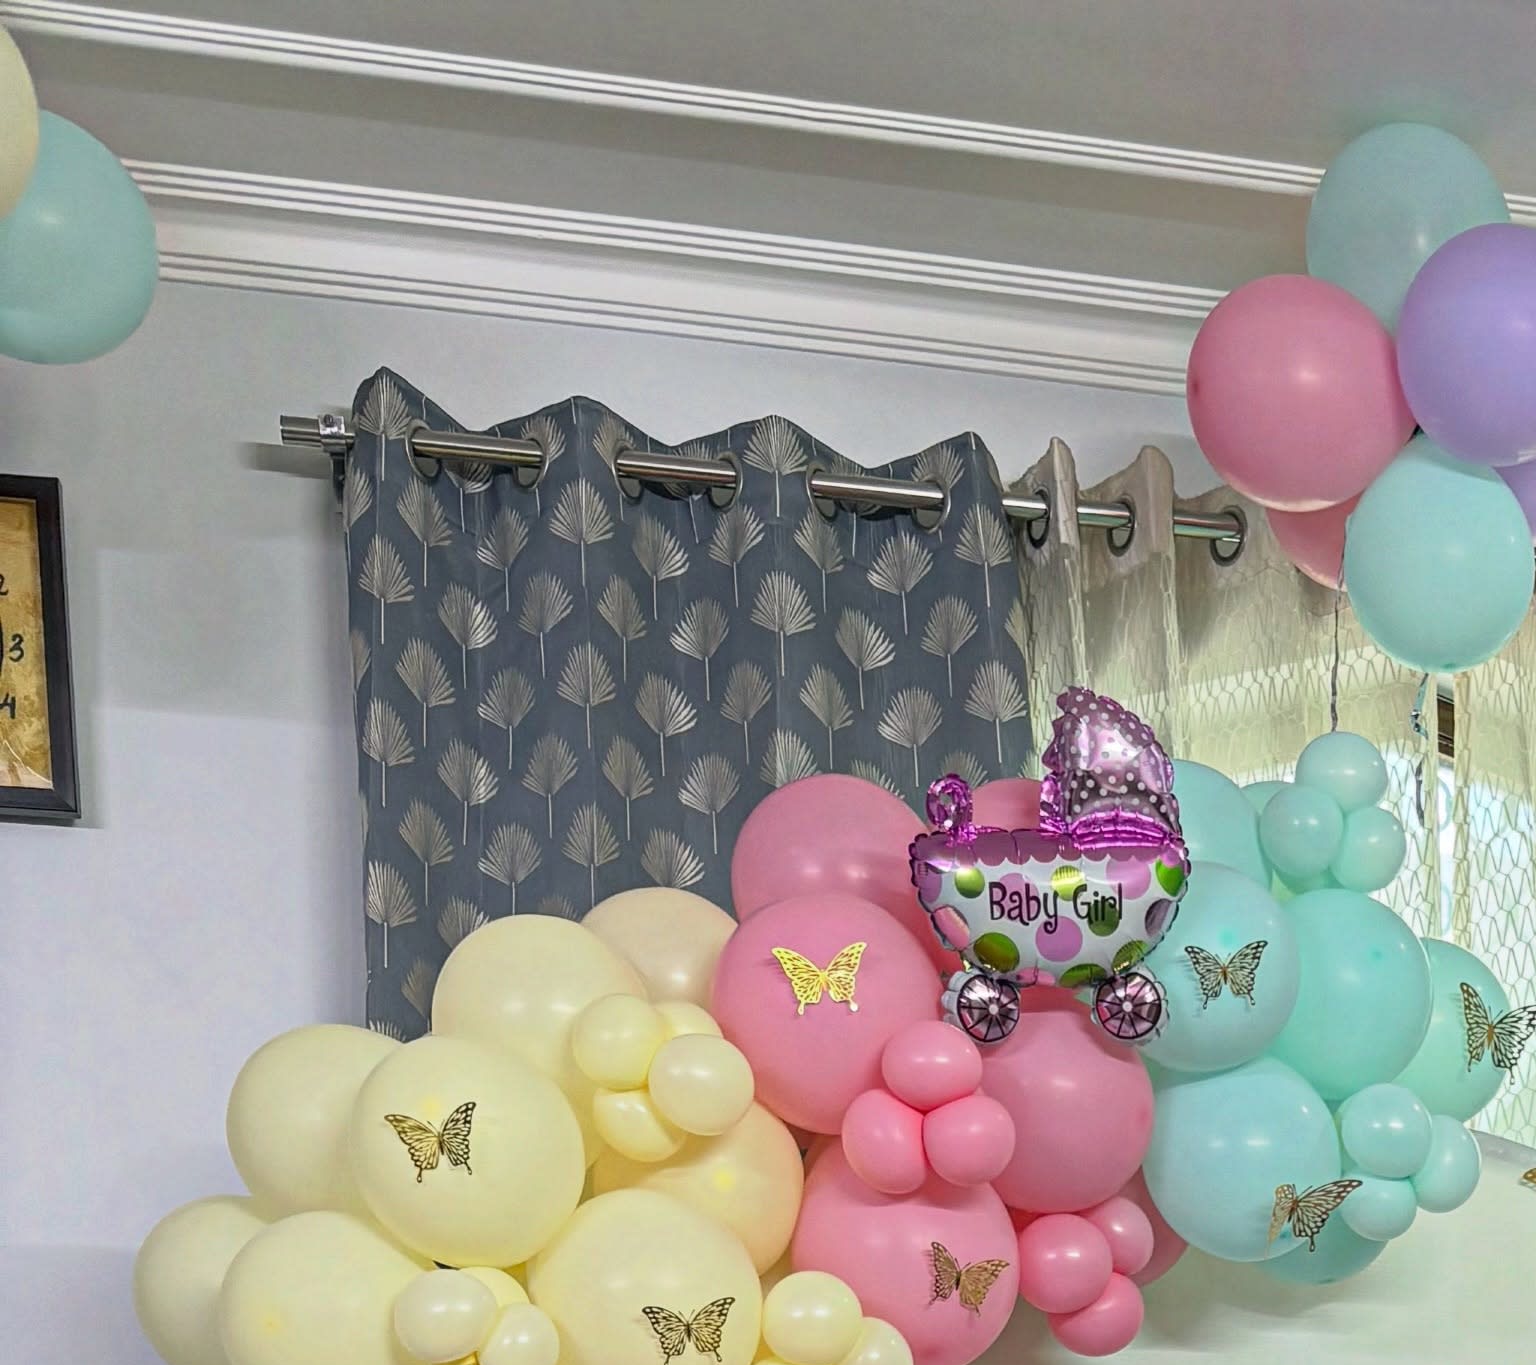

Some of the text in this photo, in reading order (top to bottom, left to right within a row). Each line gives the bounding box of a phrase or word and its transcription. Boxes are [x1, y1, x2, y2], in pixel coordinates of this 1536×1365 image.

[9, 633, 25, 662] 3
[0, 692, 16, 719] 4
[988, 881, 1123, 935] Baby Girl
